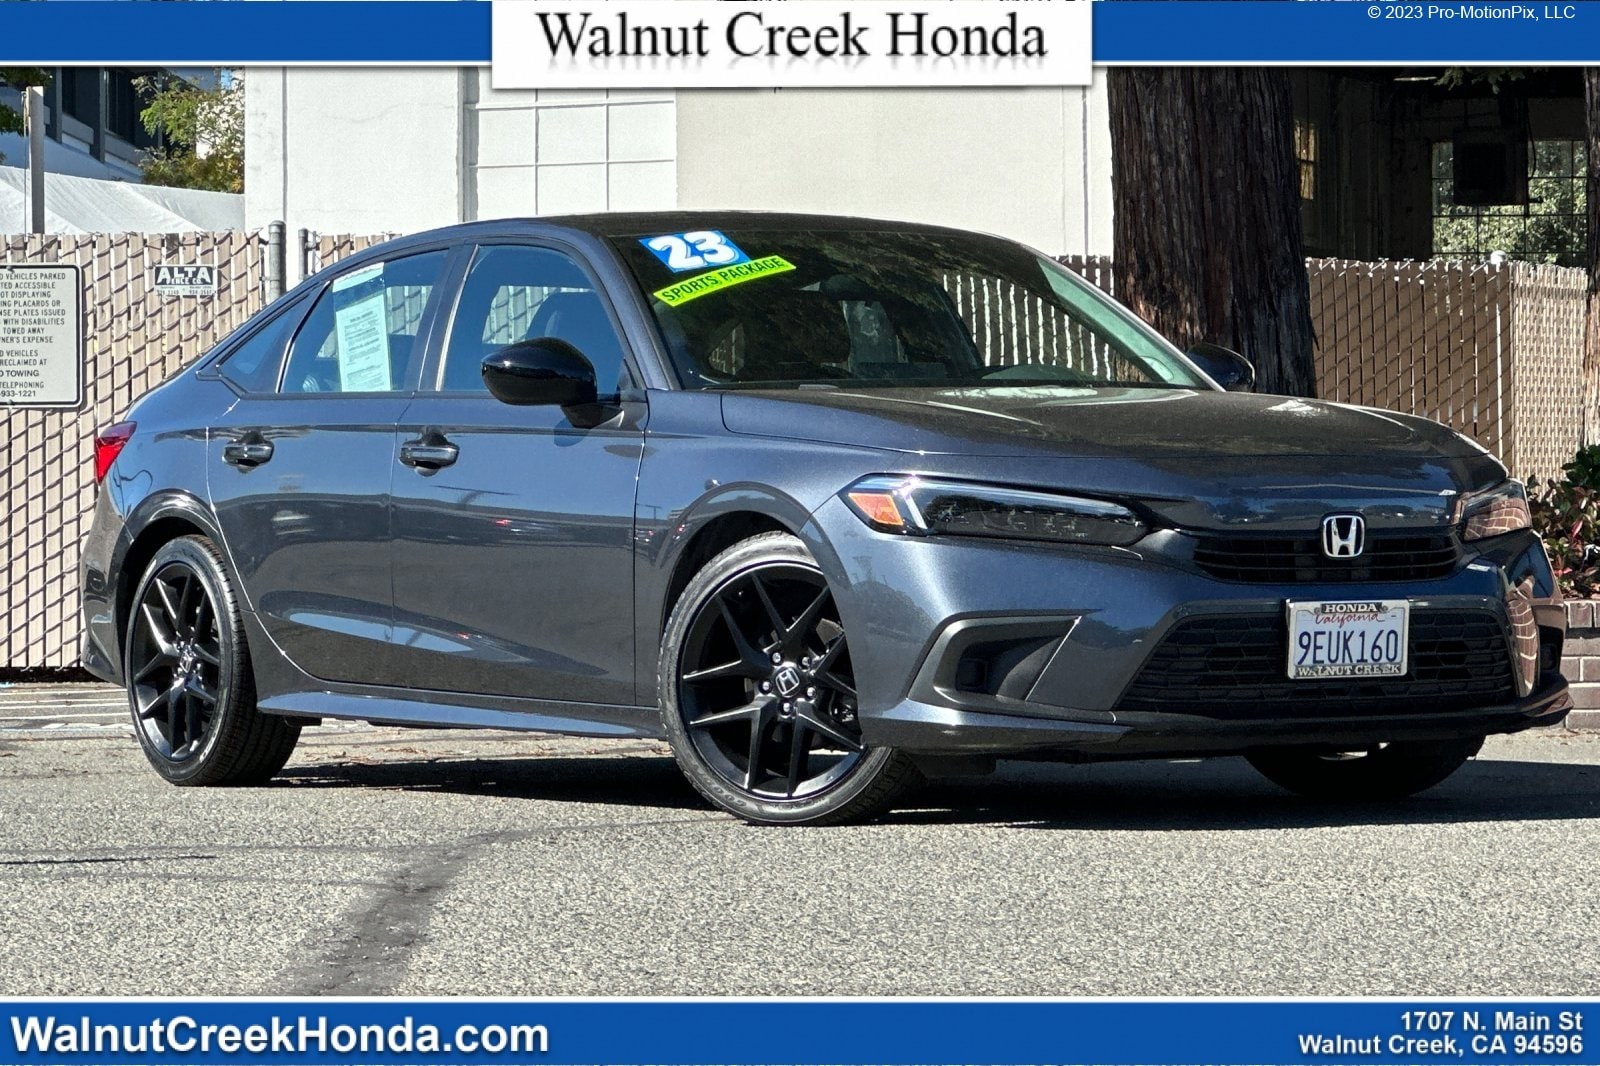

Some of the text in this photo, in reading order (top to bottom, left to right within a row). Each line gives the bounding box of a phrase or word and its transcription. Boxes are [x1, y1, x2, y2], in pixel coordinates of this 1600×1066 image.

[648, 231, 737, 269] 23
[40, 272, 66, 280] PARKED
[156, 266, 211, 284] ALTA
[662, 257, 785, 302] SPORTS PACKAGE
[1325, 603, 1378, 613] HONDA
[1315, 613, 1385, 628] California
[1297, 629, 1399, 665] 9EUK160
[1298, 664, 1400, 677] WALNUT CREEK
